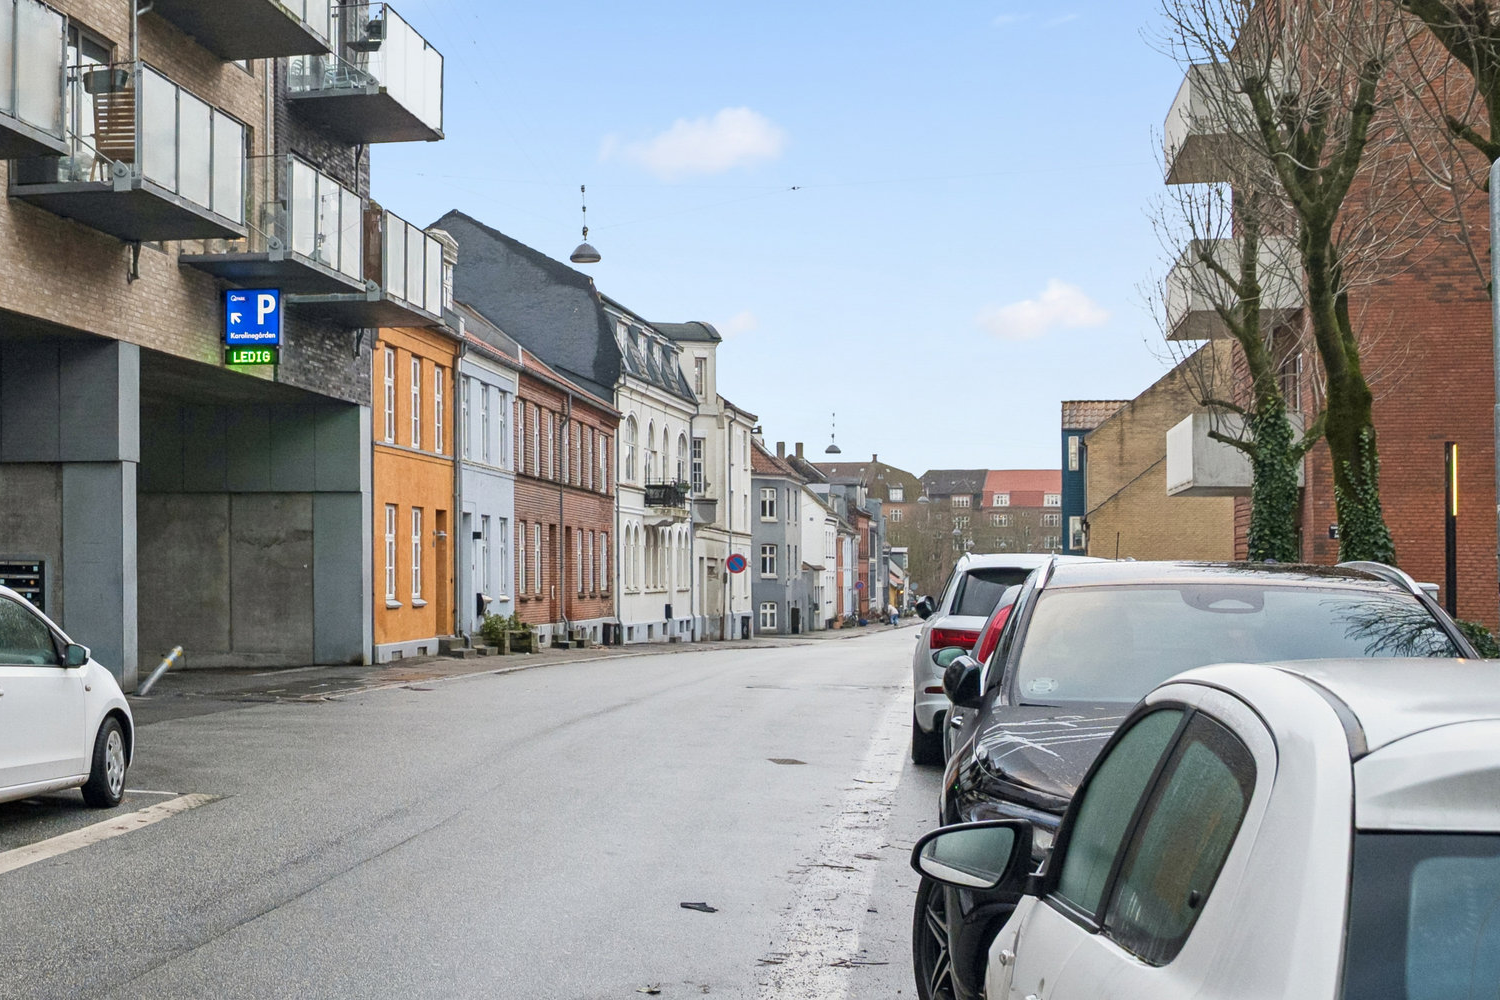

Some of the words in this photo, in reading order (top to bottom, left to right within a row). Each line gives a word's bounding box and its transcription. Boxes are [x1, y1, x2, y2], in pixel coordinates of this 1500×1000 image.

[257, 294, 276, 325] P
[230, 331, 276, 340] Karolinegården
[233, 351, 271, 363] LEDIG
